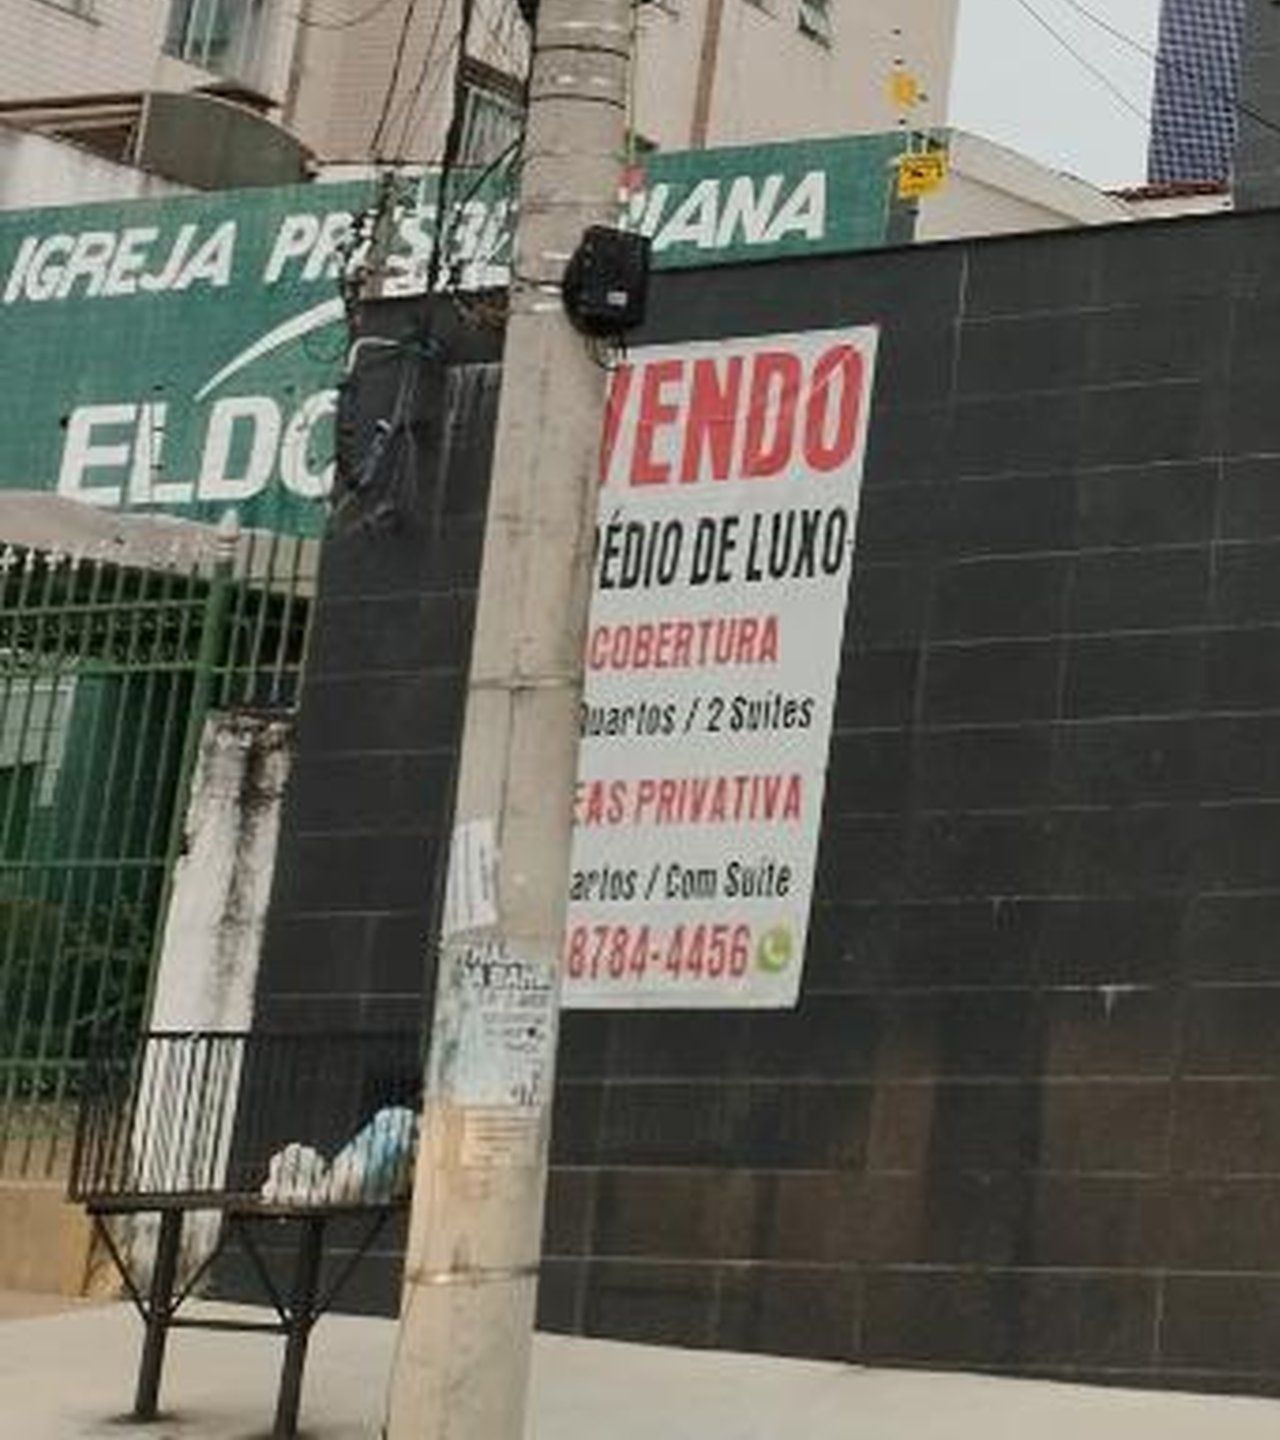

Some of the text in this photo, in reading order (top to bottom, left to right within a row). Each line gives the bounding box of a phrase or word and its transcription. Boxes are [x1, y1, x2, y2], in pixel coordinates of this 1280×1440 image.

[2, 220, 239, 304] IGREJA
[597, 506, 848, 590] ÉDIO DE LUXO
[589, 615, 778, 670] COBERTURA
[707, 697, 726, 732] 2
[634, 773, 804, 824] PRIVATIVA
[666, 863, 718, 898] Com
[568, 924, 750, 981] 8784-4456
